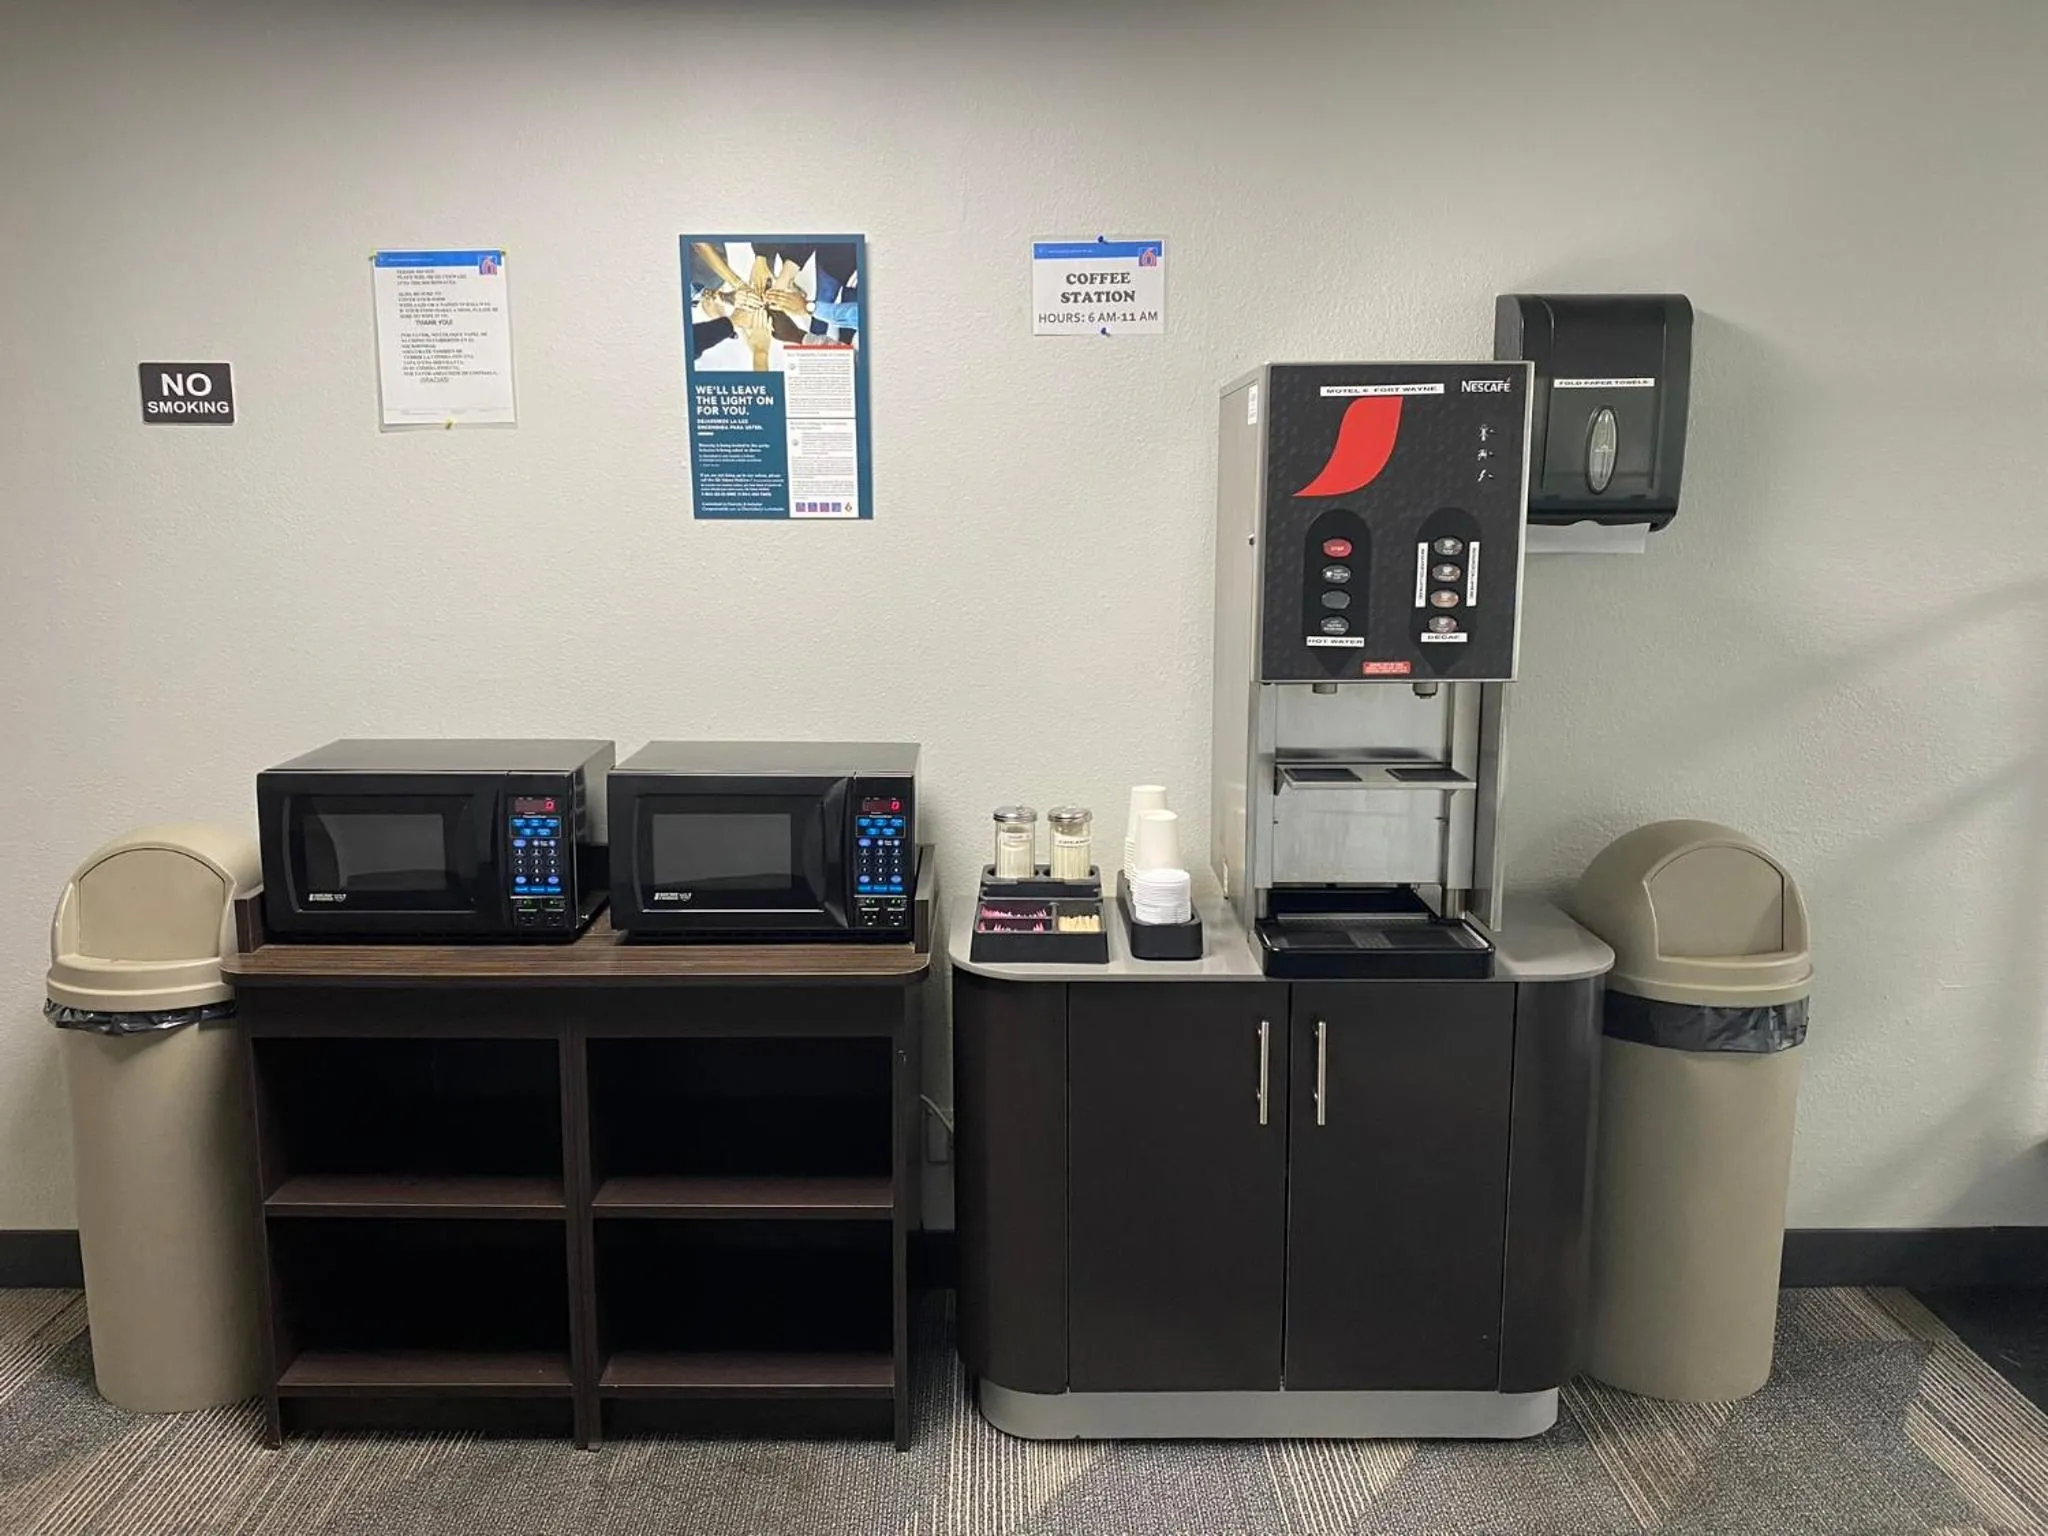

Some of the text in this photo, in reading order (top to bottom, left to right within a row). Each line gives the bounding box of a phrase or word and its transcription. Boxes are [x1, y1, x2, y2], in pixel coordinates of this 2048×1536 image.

[1066, 272, 1131, 285] COFFEE
[1060, 290, 1136, 304] STATION
[1038, 311, 1158, 324] HOURS: 6 AM-11 AM
[161, 372, 212, 397] NO
[695, 386, 767, 395] WE'LL LEAVE
[696, 396, 774, 405] THE LIGHT ON
[147, 401, 229, 414] SMOKING
[697, 406, 750, 415] FOR YOU.
